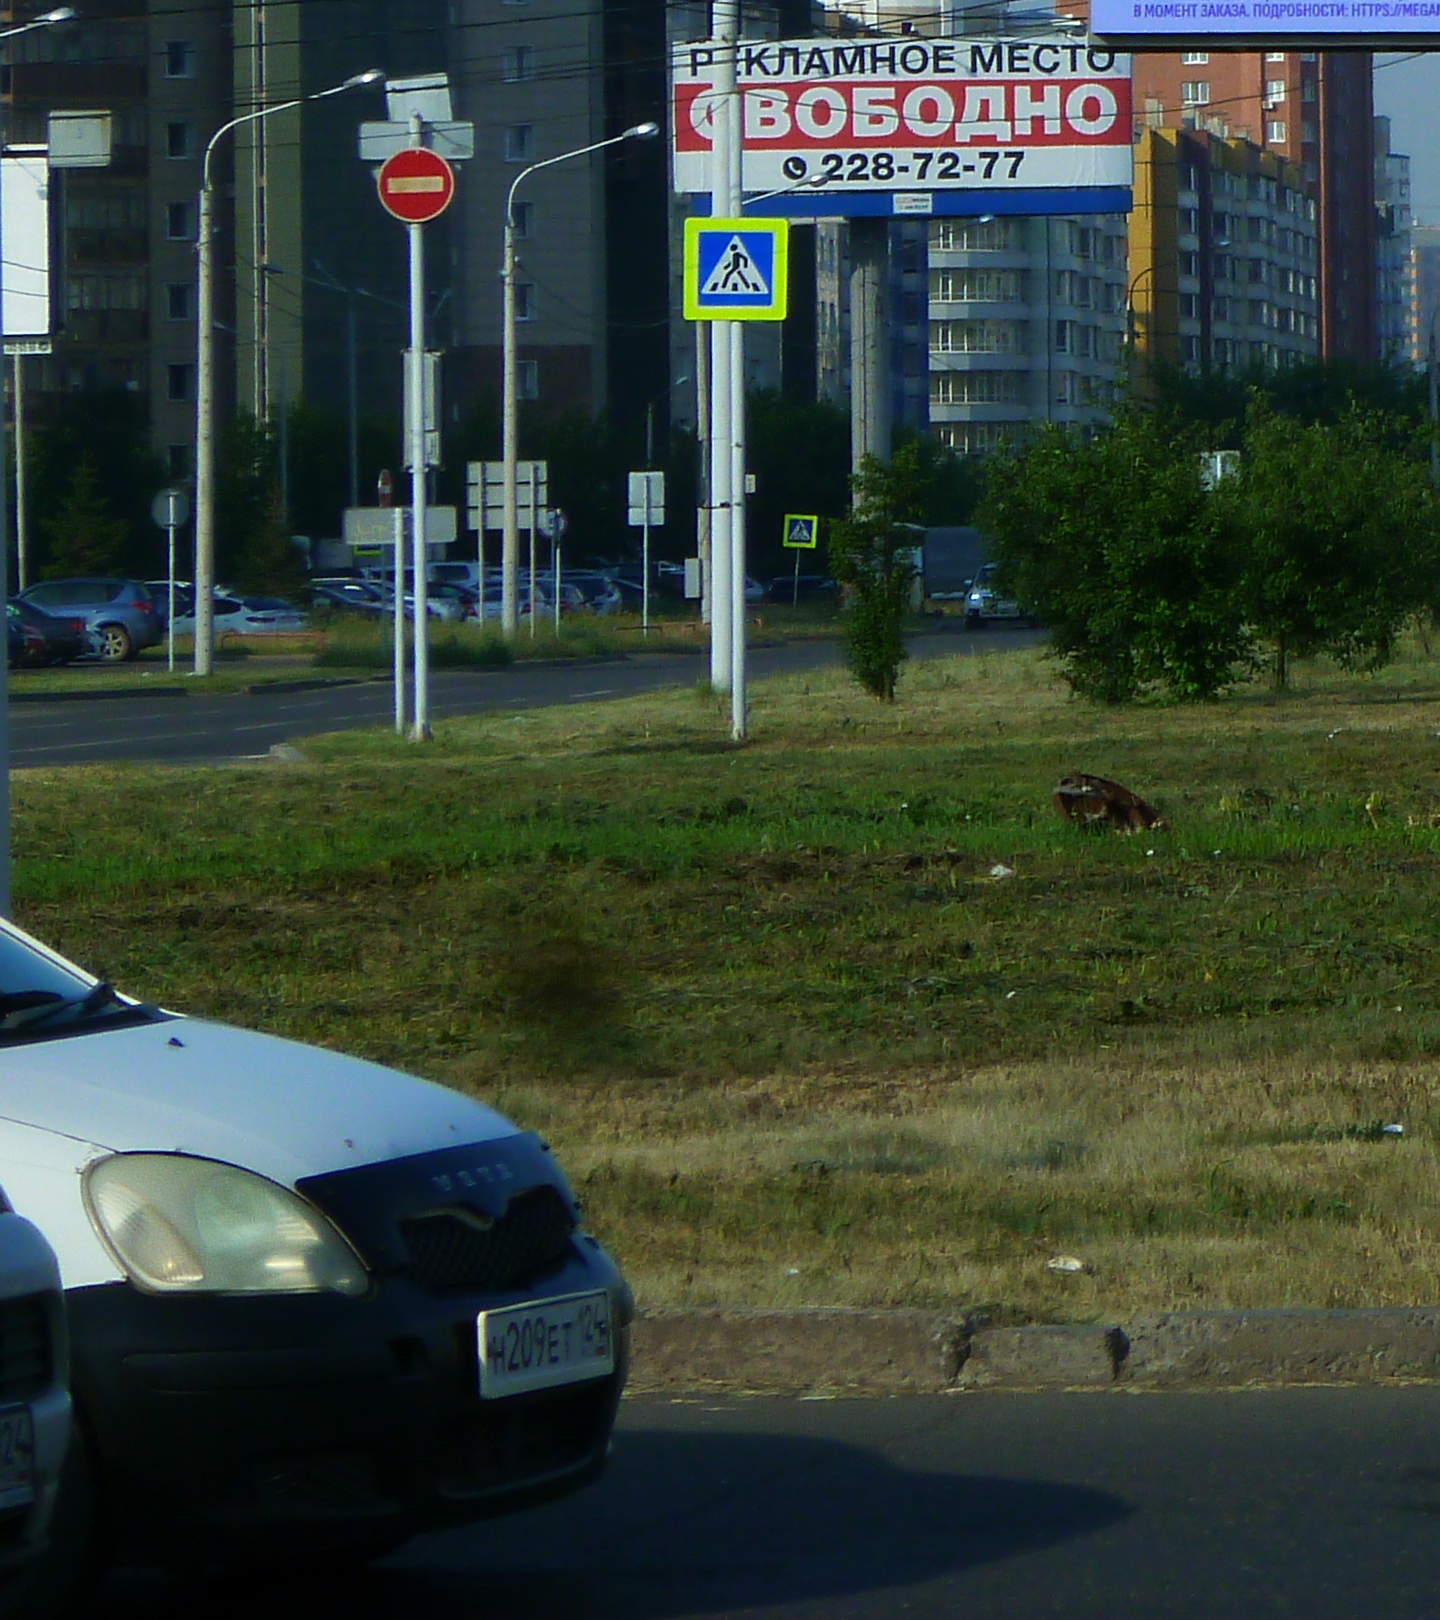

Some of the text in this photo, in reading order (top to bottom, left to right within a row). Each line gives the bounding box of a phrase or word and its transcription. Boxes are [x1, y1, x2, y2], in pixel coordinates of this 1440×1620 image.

[1134, 4, 1142, 18] В
[1145, 4, 1198, 18] МОМЕНТ
[1201, 4, 1250, 18] ЗАКАЗА.
[1253, 3, 1349, 20] ПОДРОБНОСТИ:
[689, 43, 1116, 78] РКЛАМНОЕ МЕСТО
[820, 150, 1027, 182] 228-72-77
[491, 1315, 572, 1375] Н209ЕТ
